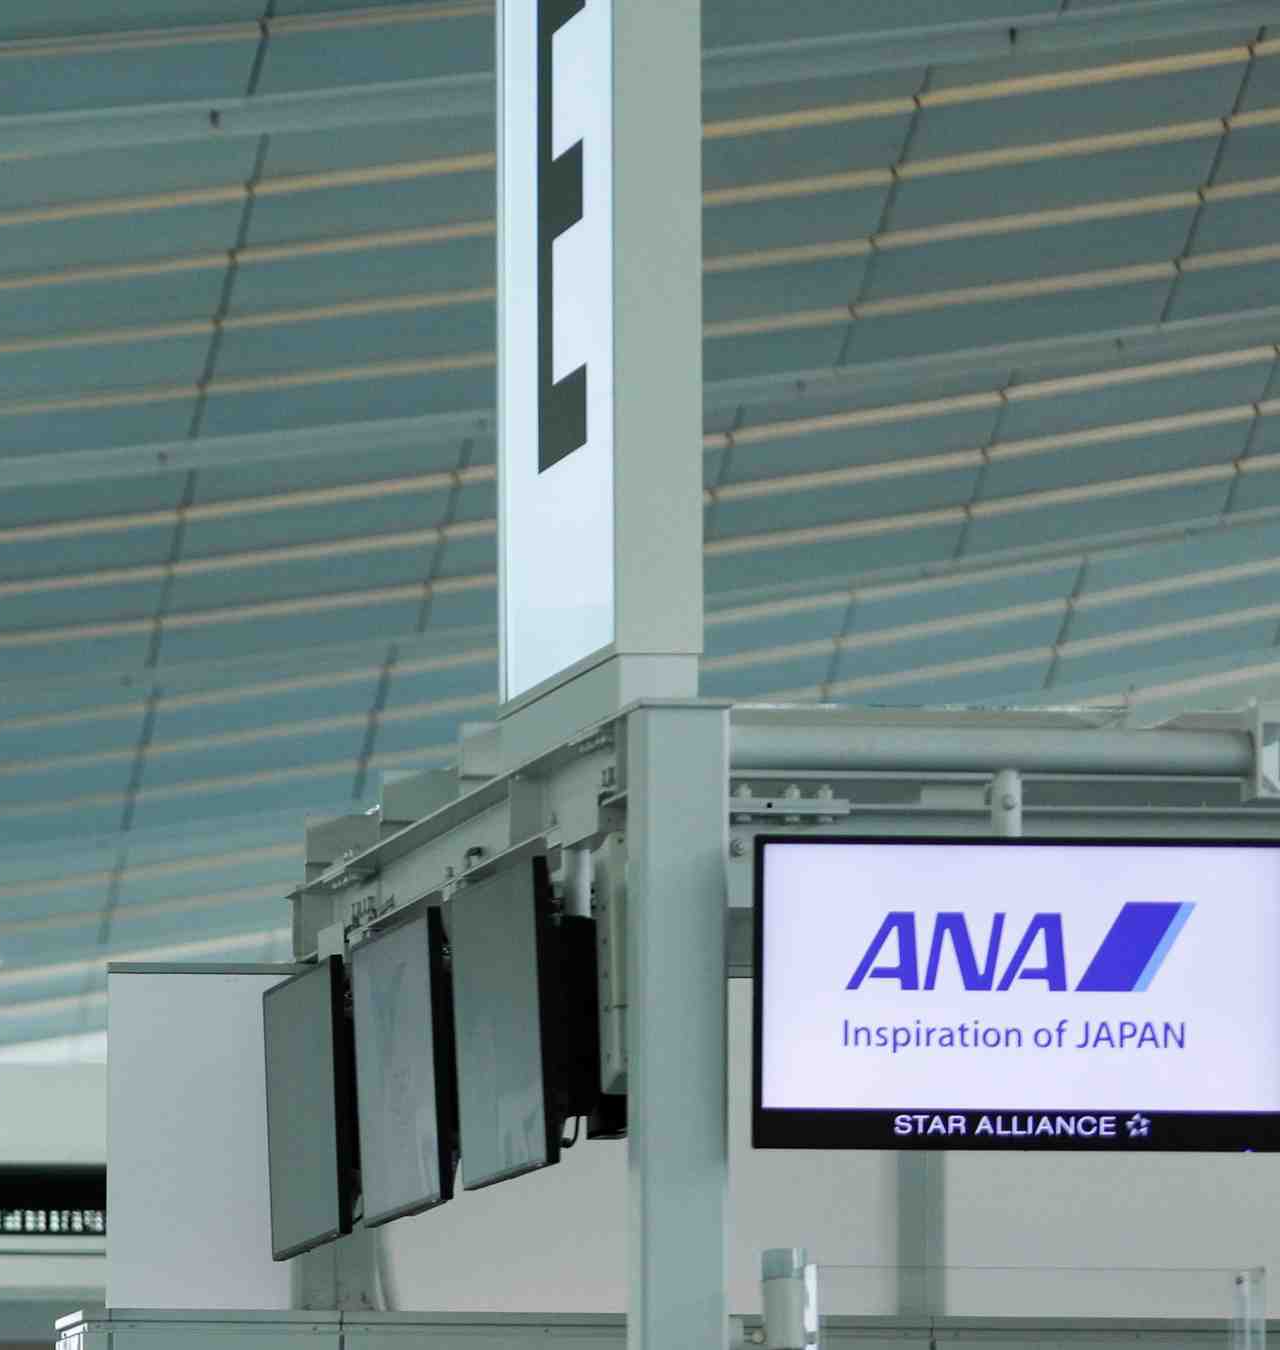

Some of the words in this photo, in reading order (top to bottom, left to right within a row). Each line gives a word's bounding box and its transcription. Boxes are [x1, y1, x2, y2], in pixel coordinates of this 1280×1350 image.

[845, 911, 1068, 992] ANA
[842, 1019, 1023, 1053] Inspiration
[1033, 1020, 1069, 1049] of
[1074, 1021, 1186, 1049] JAPAN
[893, 1114, 966, 1136] STAR
[975, 1115, 1117, 1137] ALLIANCE
